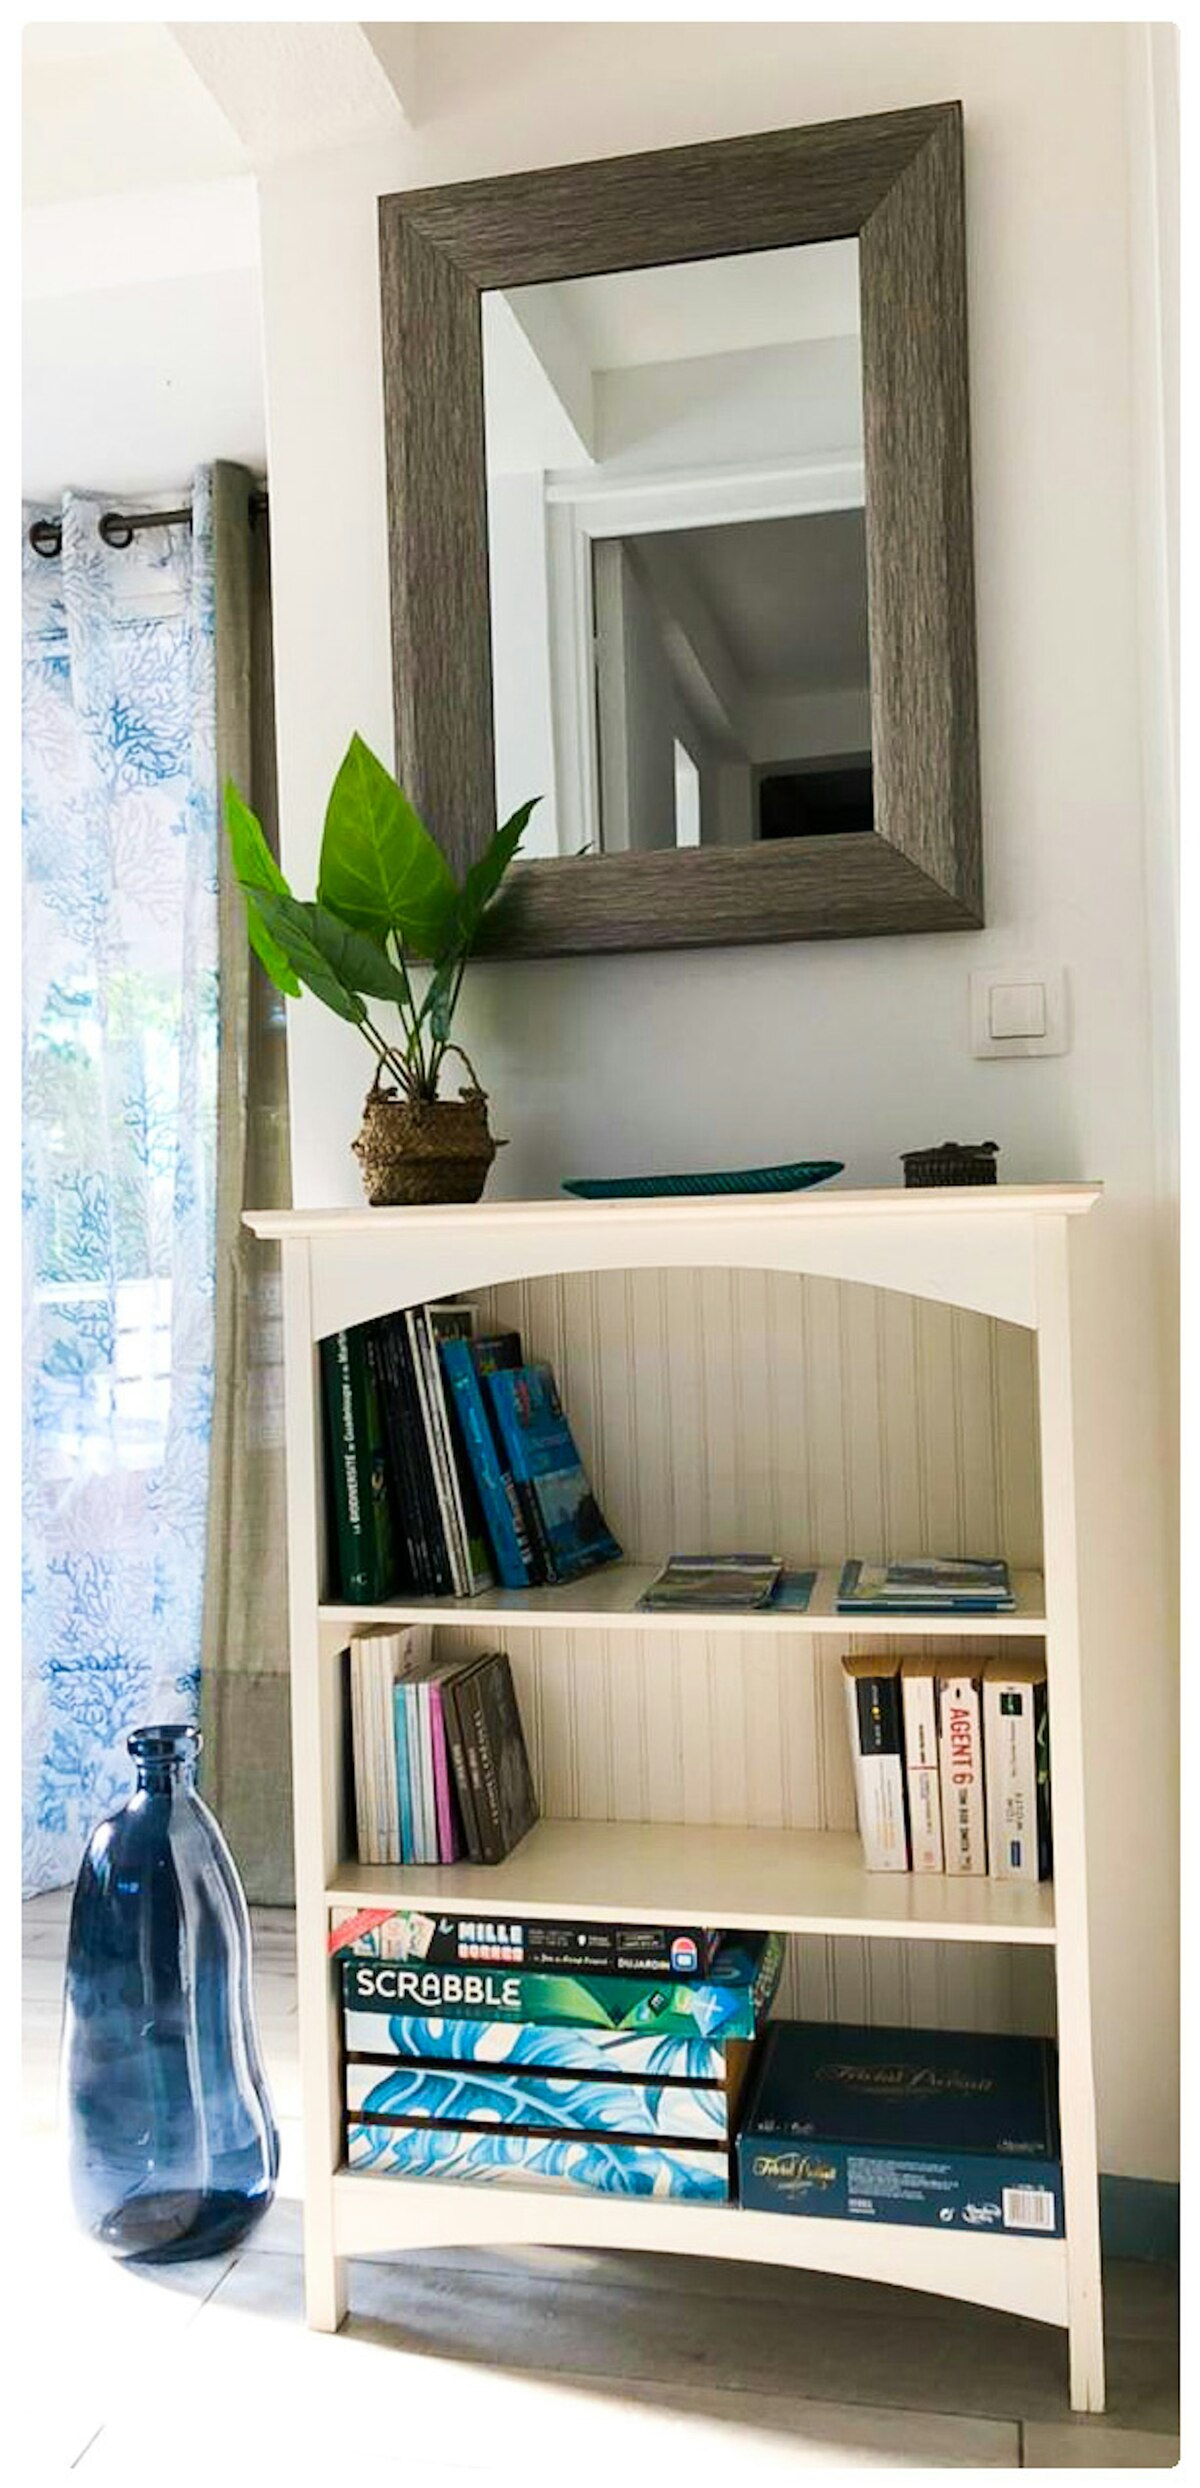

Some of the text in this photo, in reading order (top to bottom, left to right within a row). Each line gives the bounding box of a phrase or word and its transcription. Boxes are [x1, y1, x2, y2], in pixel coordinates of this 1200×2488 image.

[950, 1708, 973, 1768] AGENT
[952, 1773, 974, 1785] 6
[457, 1922, 523, 1945] MILLE
[356, 1969, 522, 2006] SCRABBLE
